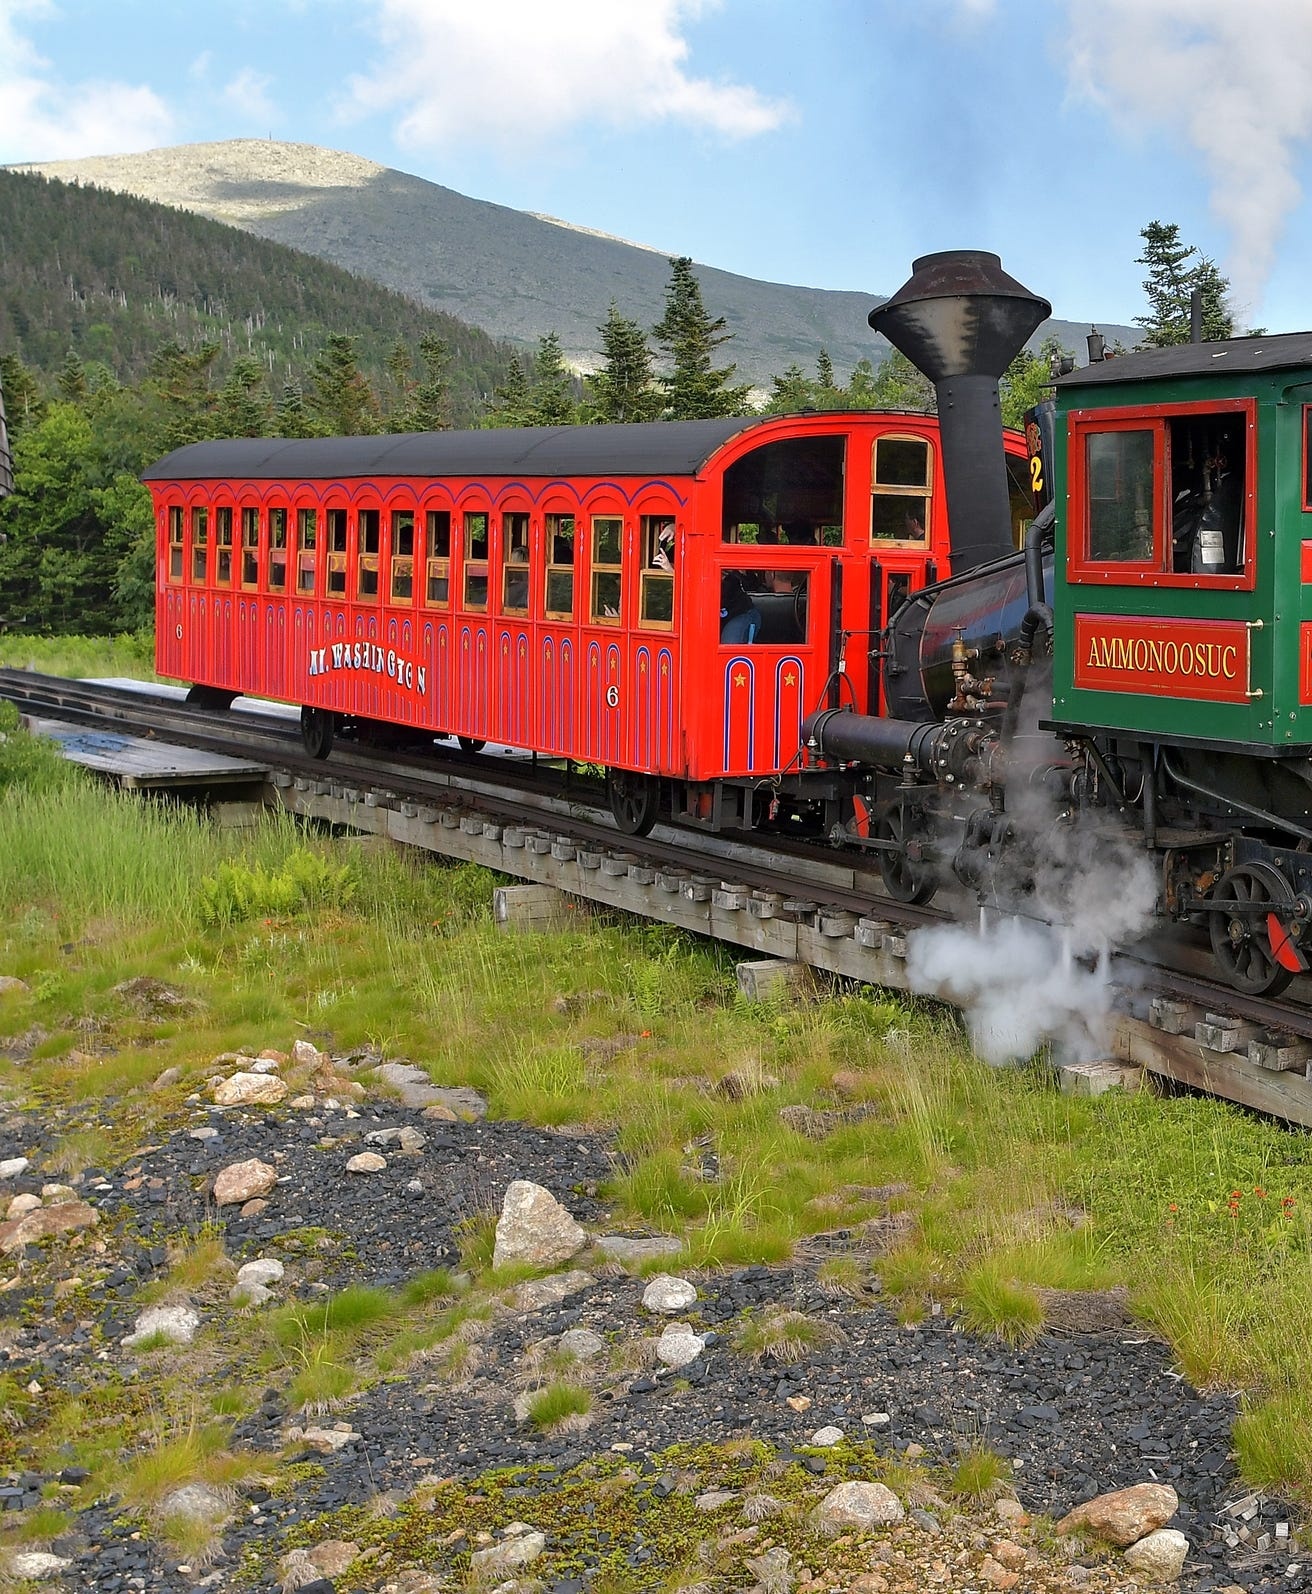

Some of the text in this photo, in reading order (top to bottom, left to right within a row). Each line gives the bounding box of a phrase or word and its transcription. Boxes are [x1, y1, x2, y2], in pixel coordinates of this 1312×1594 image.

[1030, 456, 1044, 492] 2
[176, 623, 183, 640] 6
[331, 641, 427, 696] WASHINGTON
[1086, 636, 1237, 679] AMMONOOSUC
[606, 685, 619, 708] 6
